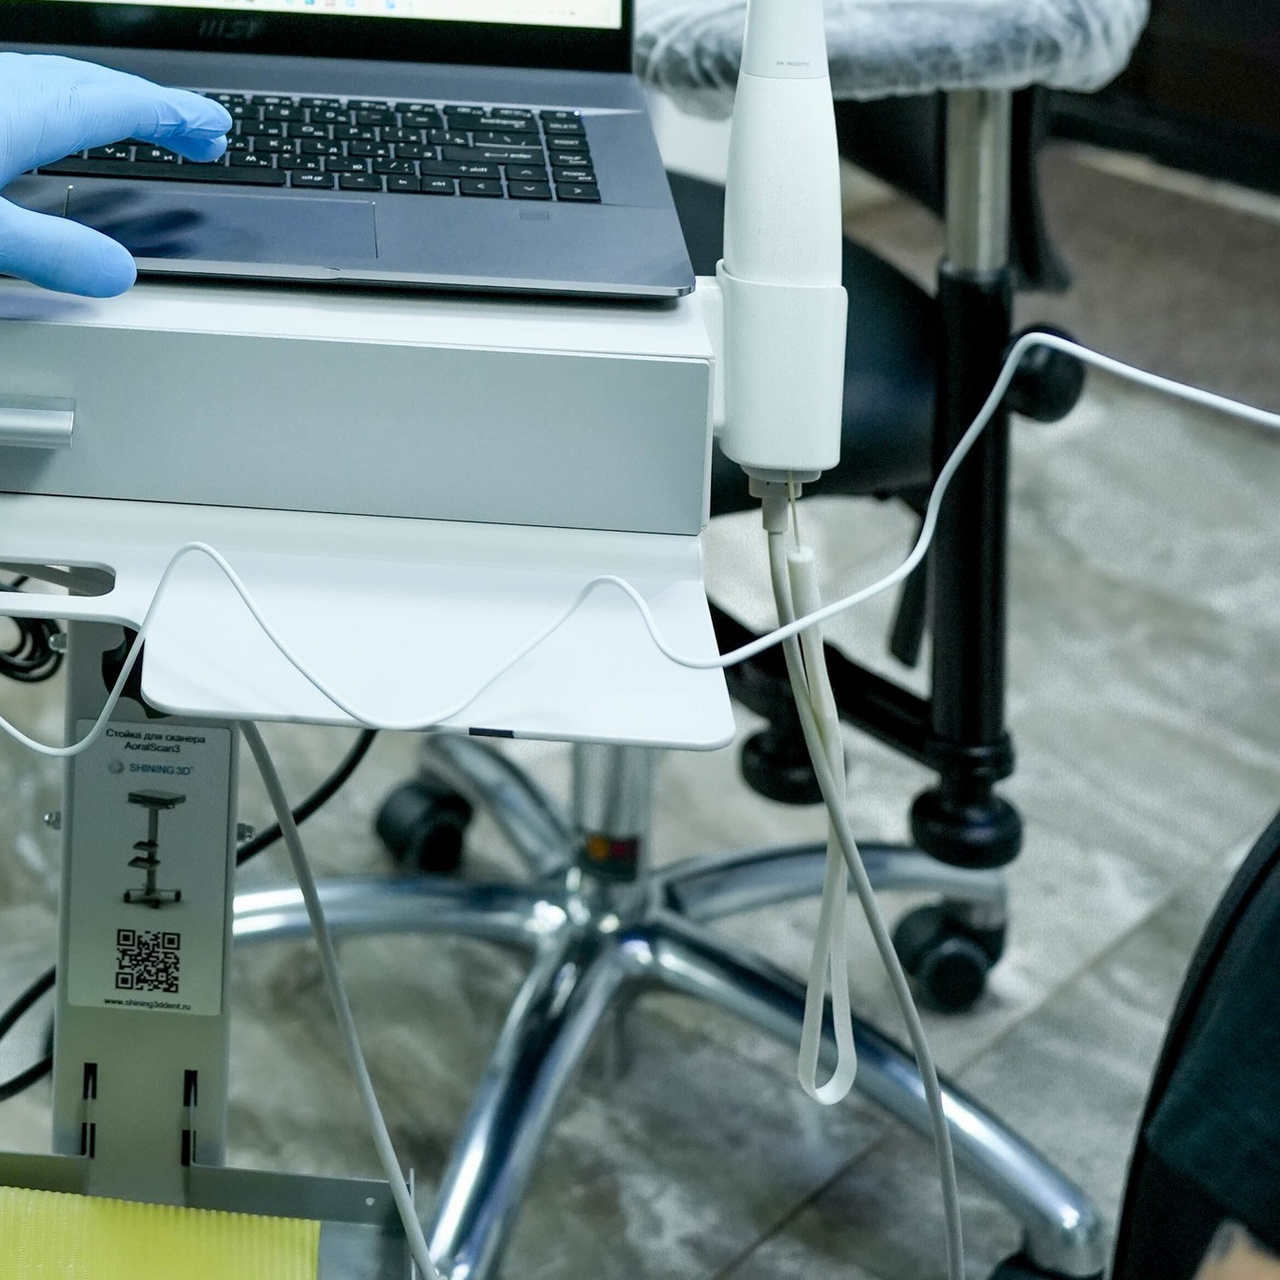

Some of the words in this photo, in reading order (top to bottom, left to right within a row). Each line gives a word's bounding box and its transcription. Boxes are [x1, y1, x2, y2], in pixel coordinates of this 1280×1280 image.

[106, 728, 142, 740] Стойка
[144, 732, 163, 741] для
[165, 734, 206, 745] сканера
[124, 741, 181, 754] AoralScan3
[129, 762, 175, 775] SHINING
[176, 765, 191, 776] 3D
